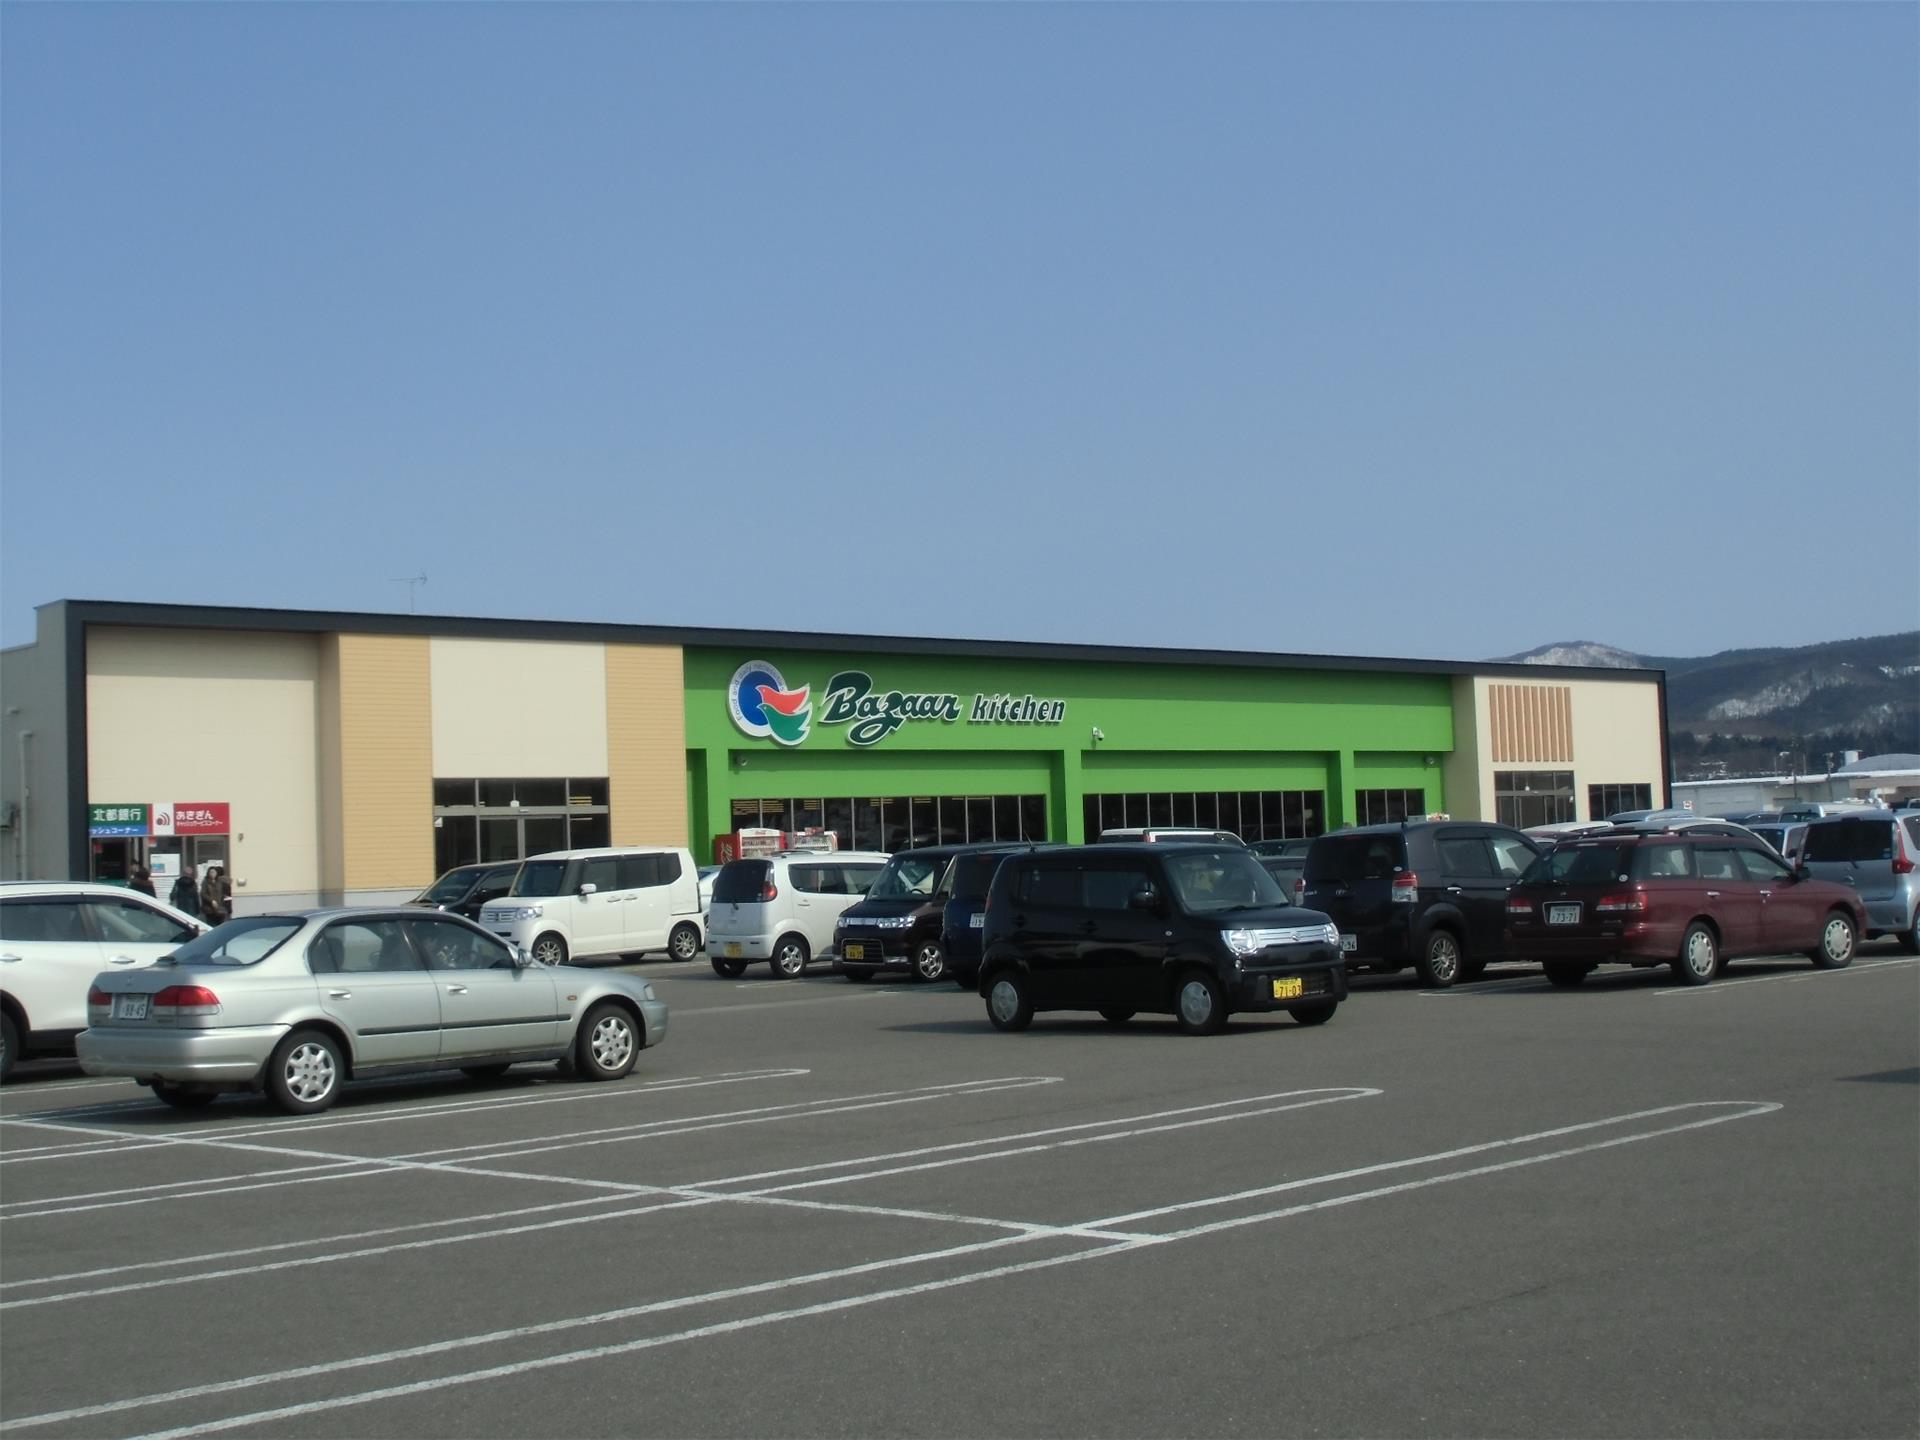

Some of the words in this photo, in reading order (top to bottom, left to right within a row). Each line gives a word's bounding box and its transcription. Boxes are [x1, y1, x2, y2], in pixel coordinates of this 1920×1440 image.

[818, 670, 963, 746] Bazaar
[971, 693, 1066, 723] kitchen
[93, 808, 142, 821] 北都銀行
[175, 810, 214, 820] あきぎん
